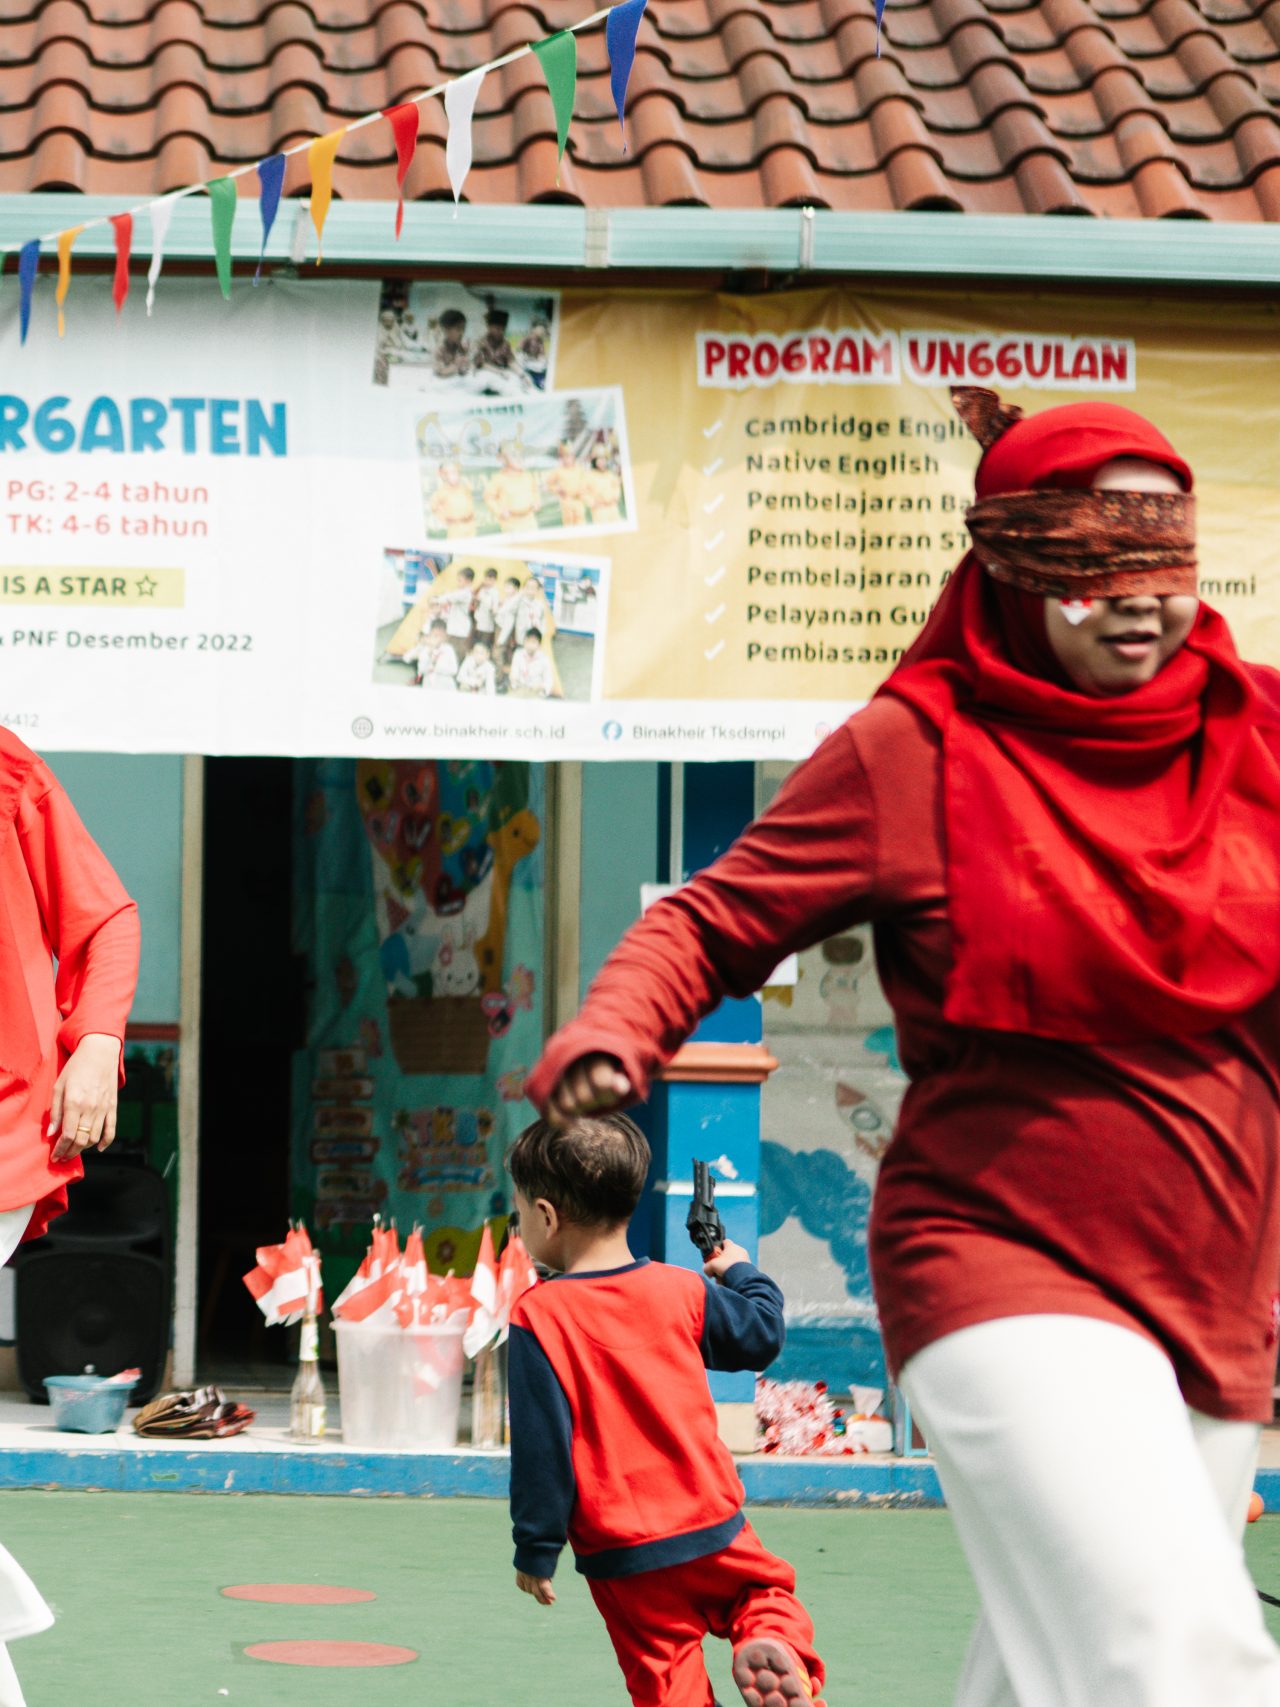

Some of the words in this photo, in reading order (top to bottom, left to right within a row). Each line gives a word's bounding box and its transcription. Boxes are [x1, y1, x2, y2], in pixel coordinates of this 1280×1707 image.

[704, 337, 893, 378] PROGRAM
[908, 339, 1128, 381] UNGGULAN
[745, 415, 890, 441] Cambridge
[747, 450, 831, 473] Native
[838, 452, 939, 477] English
[8, 480, 54, 502] PG:
[64, 481, 111, 502] 2-4
[122, 481, 208, 503] tahun
[748, 490, 932, 516] Pembelajaran
[941, 494, 972, 512] Ba
[7, 514, 52, 534] TK:
[62, 514, 110, 535] 4-6
[122, 514, 207, 536] tahun
[748, 528, 932, 555] Pembelajaran
[941, 532, 968, 550] ST
[3, 575, 26, 594] IS
[35, 576, 51, 595] A
[60, 576, 127, 597] STAR
[747, 566, 932, 592] Pembelajaran
[1199, 574, 1257, 595] mmi
[747, 603, 882, 627] Pelayanan
[13, 630, 58, 647] PNF
[66, 630, 189, 650] Desember
[197, 633, 253, 651] 2022
[632, 725, 705, 740] Binakheir
